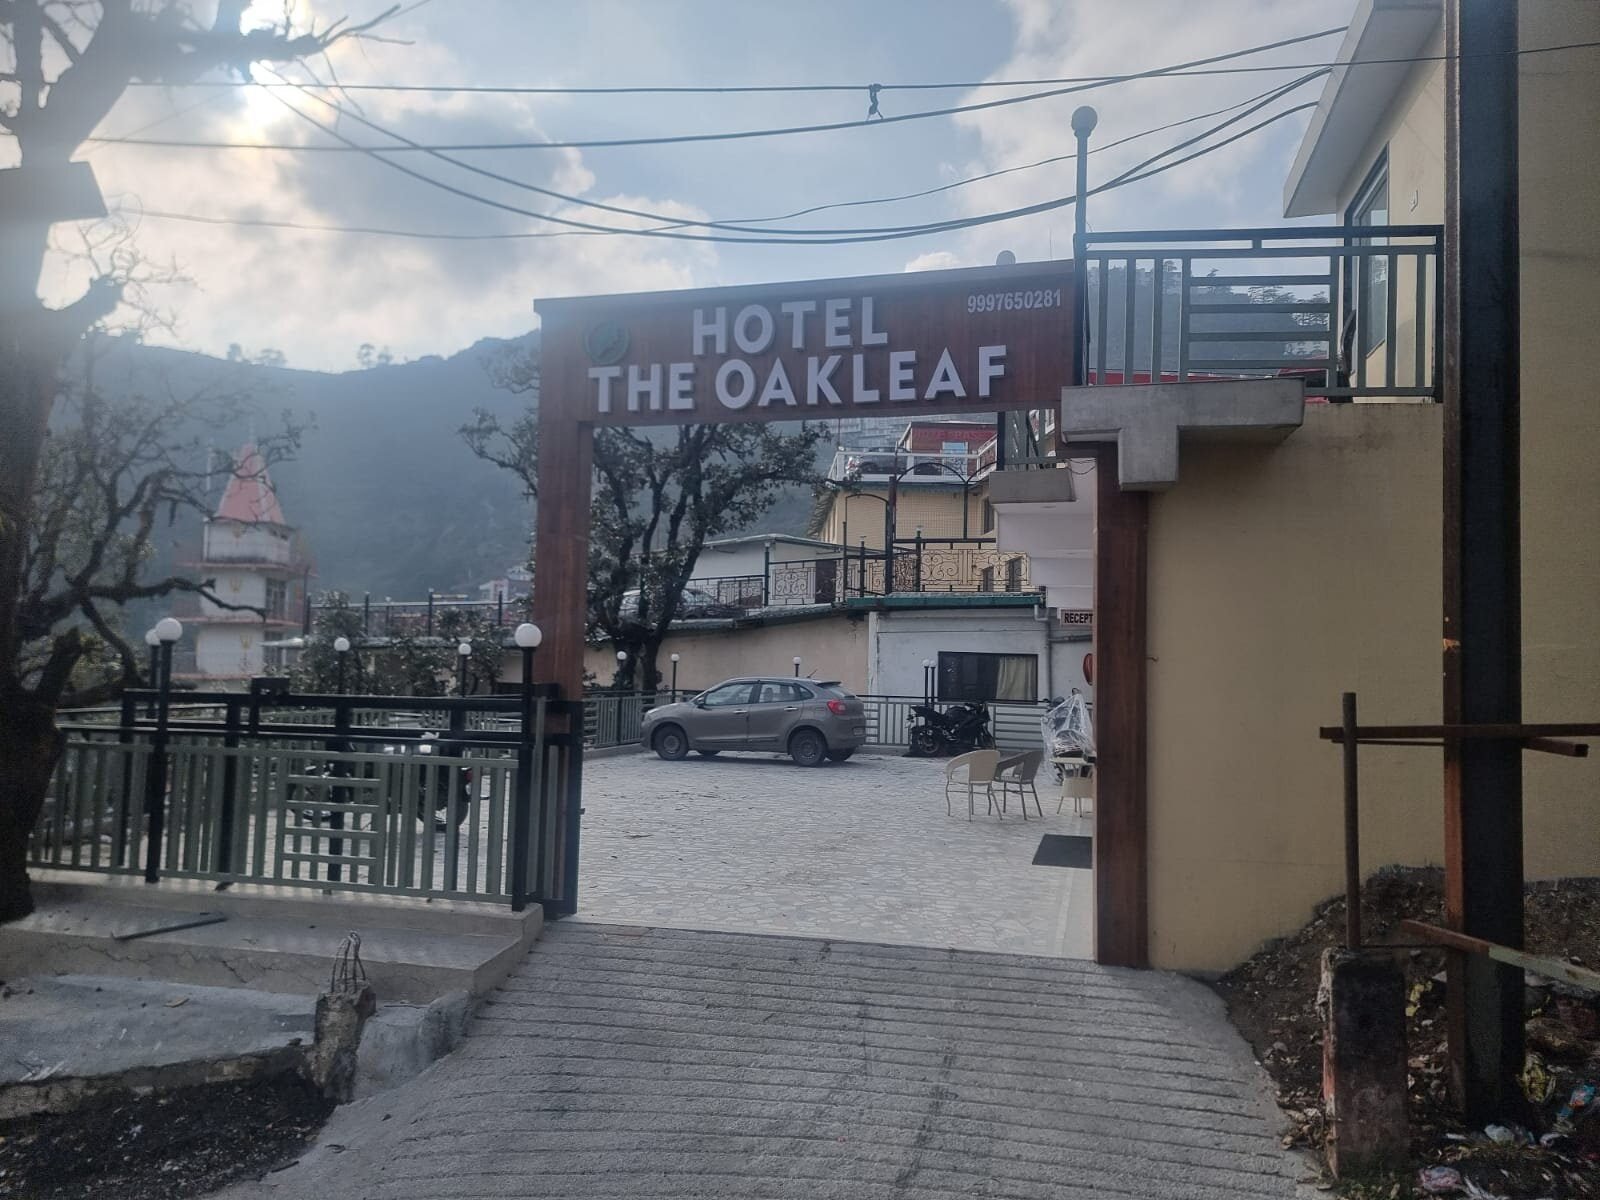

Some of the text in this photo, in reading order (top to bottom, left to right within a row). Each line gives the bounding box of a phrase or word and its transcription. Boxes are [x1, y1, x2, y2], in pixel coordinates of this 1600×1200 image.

[693, 297, 889, 356] HOTEL
[967, 288, 1061, 313] 9997650281
[588, 345, 1007, 414] THE OAKLEAF
